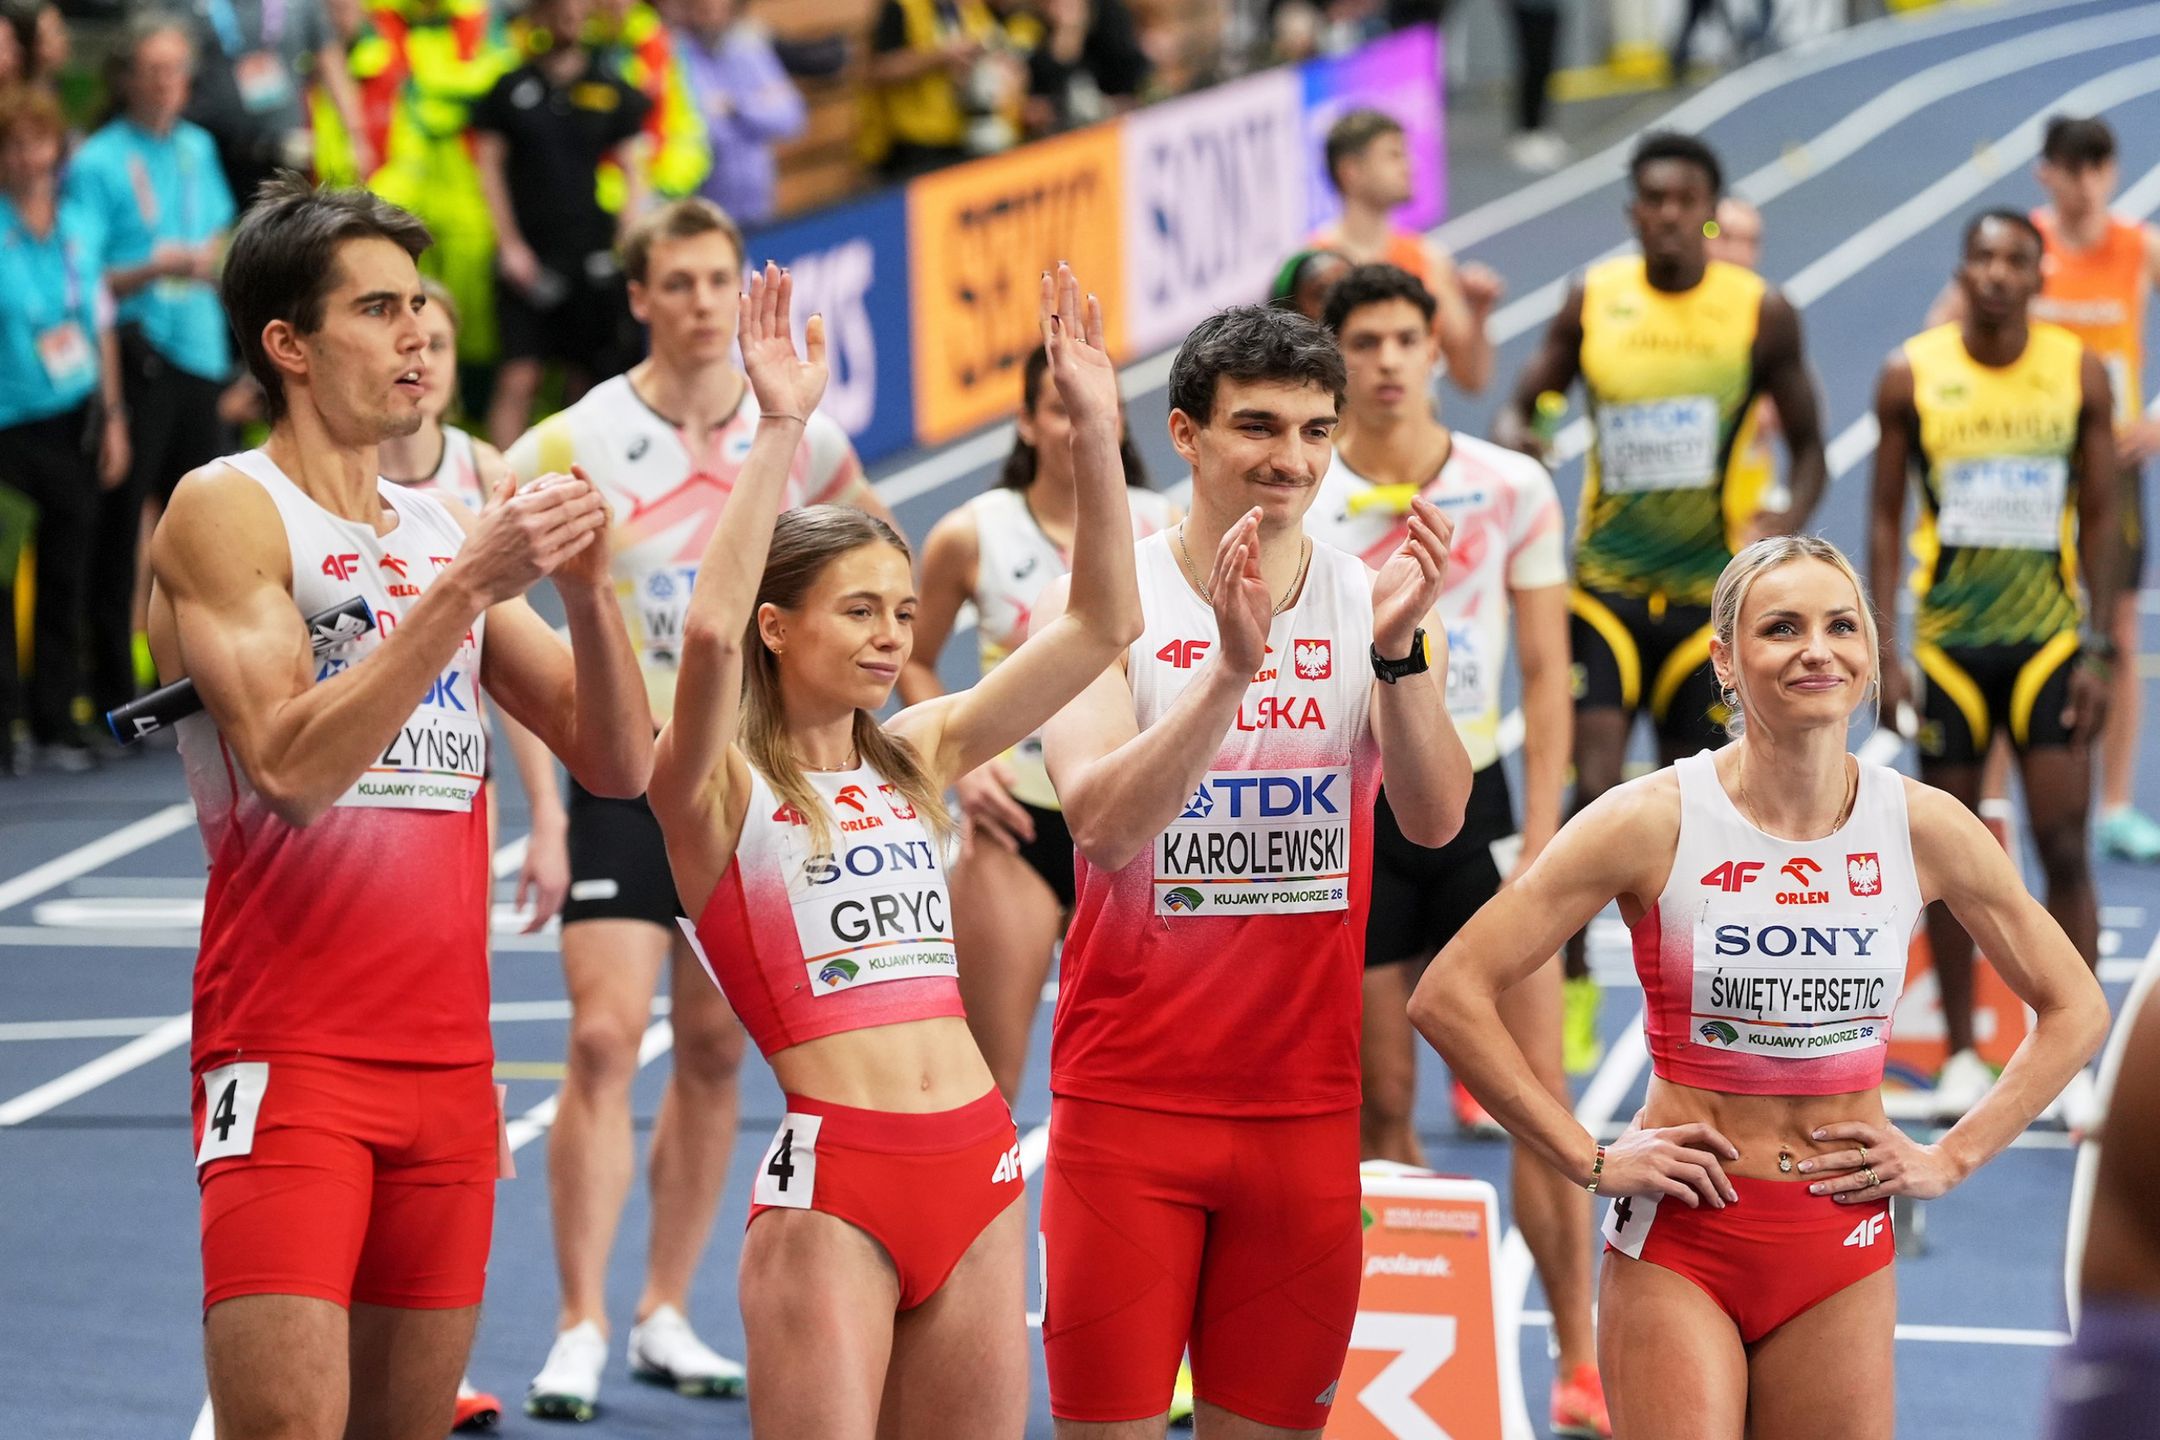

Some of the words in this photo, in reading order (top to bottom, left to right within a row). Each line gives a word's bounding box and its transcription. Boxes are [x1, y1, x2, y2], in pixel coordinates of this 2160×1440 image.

[321, 554, 359, 582] 4F
[1156, 639, 1210, 669] 4F
[1236, 696, 1326, 731] LSKA
[358, 784, 415, 796] KUJAWY
[419, 785, 466, 800] POMORZE
[1212, 774, 1339, 818] TDK
[840, 816, 883, 832] ORLEN
[802, 841, 935, 886] SONY
[1163, 827, 1344, 875] KAROLEWSKI
[1700, 860, 1765, 892] 4F
[1214, 893, 1269, 905] KUJAWY
[1272, 890, 1328, 904] POMORZE
[1331, 888, 1343, 900] 26
[1775, 891, 1829, 905] ORLEN
[830, 890, 944, 942] GRYC
[1714, 925, 1878, 957] SONY
[869, 954, 915, 970] KUJAWY
[1711, 967, 1884, 1020] ŚWIĘTY-ERSETIC
[1748, 1034, 1806, 1048] KUJAWY
[1808, 1028, 1858, 1048] POMORZE
[1860, 1026, 1874, 1038] 26
[211, 1079, 238, 1142] 4
[767, 1128, 795, 1192] 4
[1843, 1211, 1886, 1248] 4F
